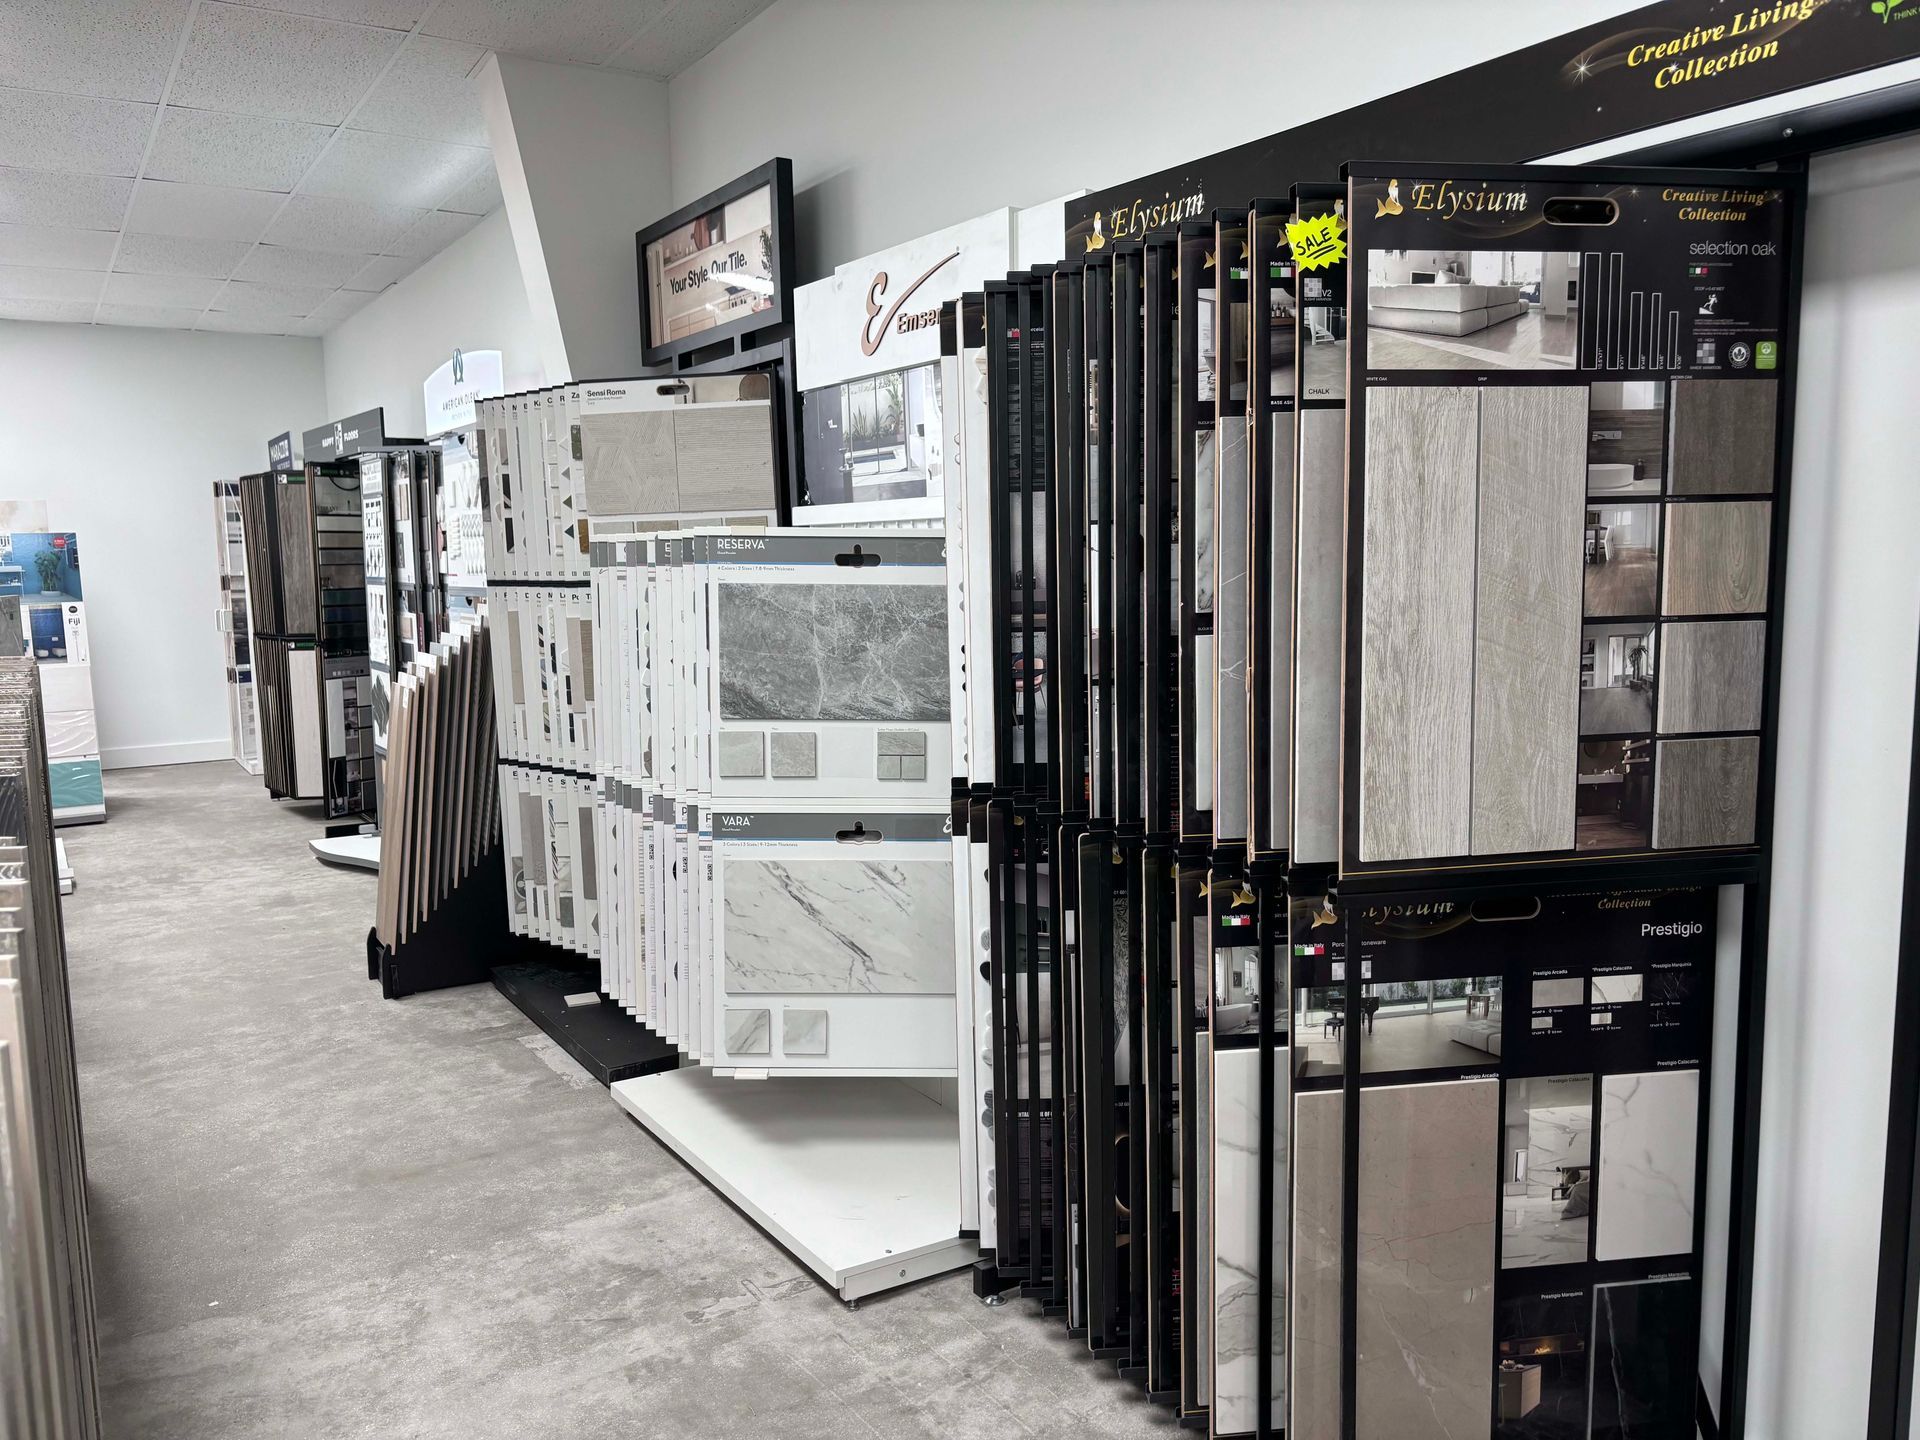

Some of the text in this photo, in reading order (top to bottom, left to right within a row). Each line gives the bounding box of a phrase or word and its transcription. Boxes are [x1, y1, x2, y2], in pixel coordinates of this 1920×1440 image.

[1627, 0, 1814, 68] Creative Living
[1654, 40, 1778, 89] Collection
[1411, 180, 1528, 220] Elysium
[1662, 189, 1766, 206] Creative Living
[1110, 192, 1205, 240] Elysium
[1679, 207, 1747, 221] Collection
[1296, 227, 1333, 256] SALE
[1689, 240, 1777, 256] selection oak
[670, 276, 687, 295] Your
[728, 251, 748, 271] Tile.
[1322, 289, 1332, 297] V2
[587, 388, 626, 397] Sensi Roma
[0, 536, 10, 547] iji
[717, 538, 766, 550] RESERVA
[722, 815, 751, 827] VARA
[1641, 921, 1703, 938] Prestigio
